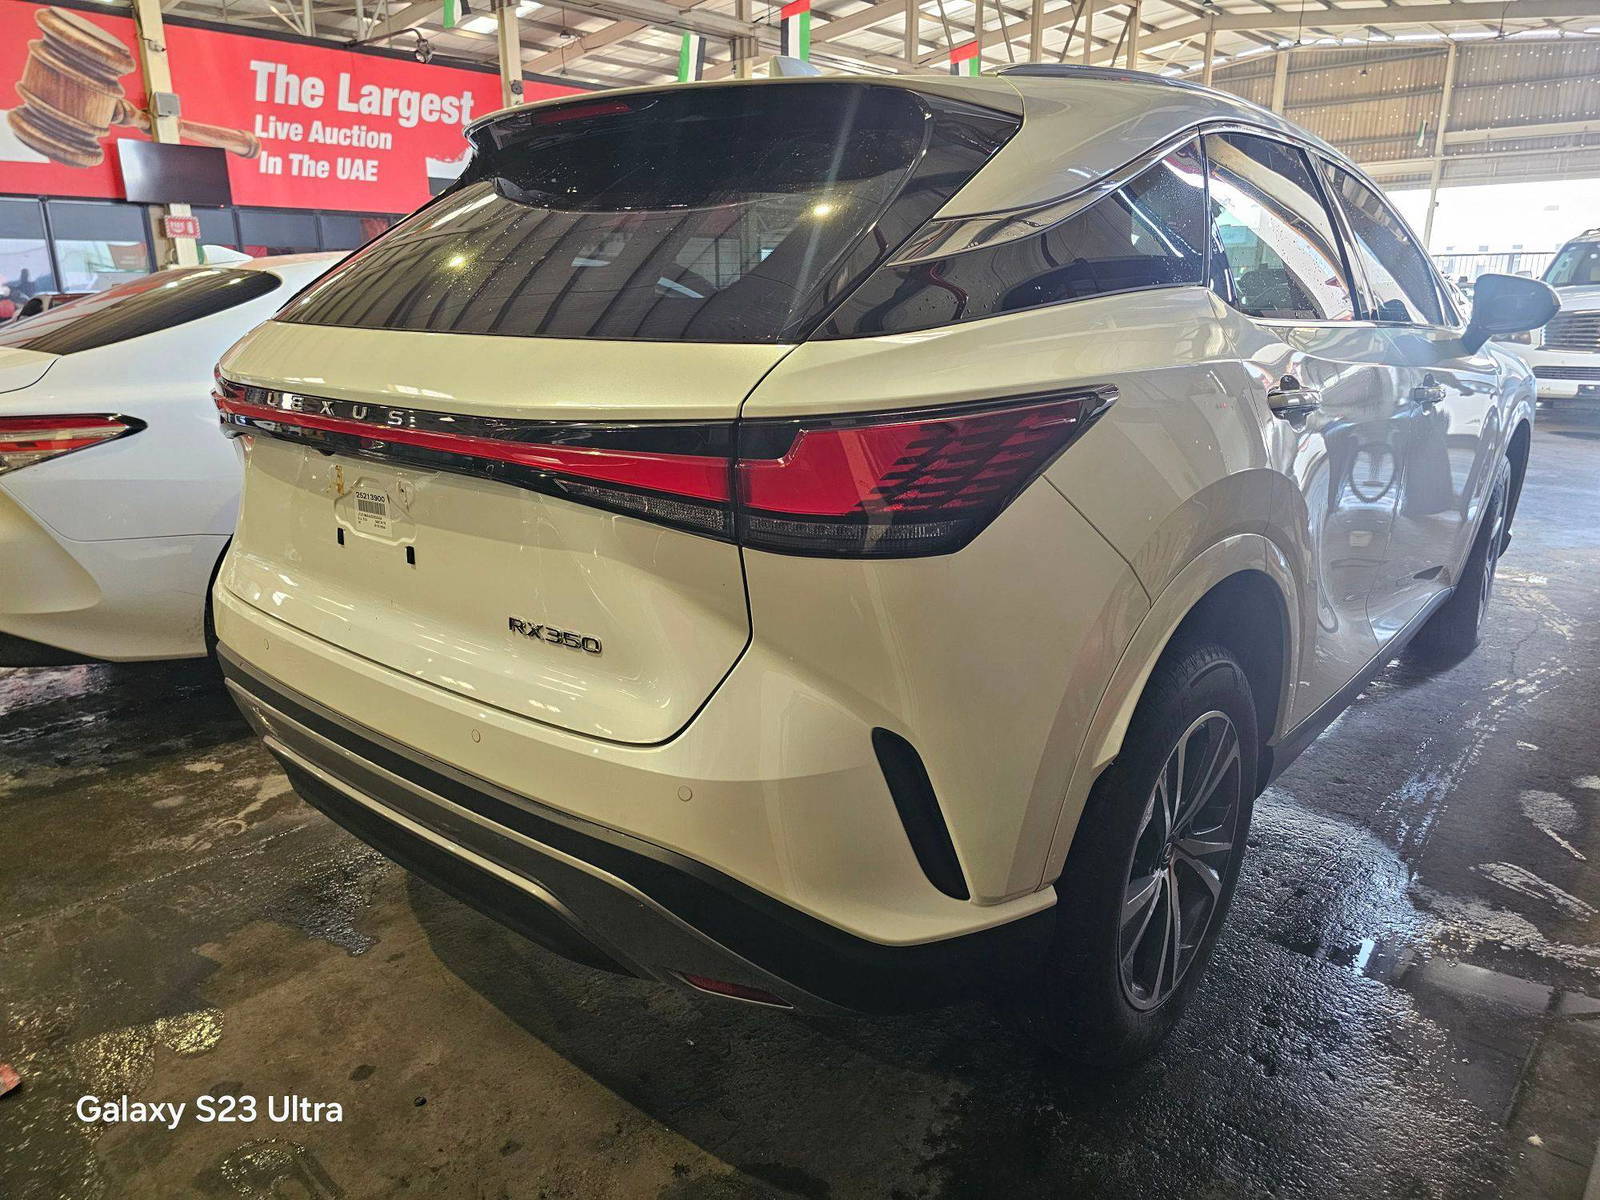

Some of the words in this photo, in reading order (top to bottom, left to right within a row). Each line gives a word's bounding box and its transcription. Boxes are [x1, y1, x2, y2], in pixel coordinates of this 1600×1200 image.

[250, 60, 325, 109] The
[338, 73, 474, 128] Largest
[254, 115, 304, 142] Live
[308, 121, 393, 150] Auction
[259, 151, 283, 175] In
[288, 154, 330, 179] The
[336, 157, 379, 181] UAE
[266, 391, 404, 426] LEXUS
[355, 491, 386, 503] 25213900
[508, 616, 603, 655] RX350
